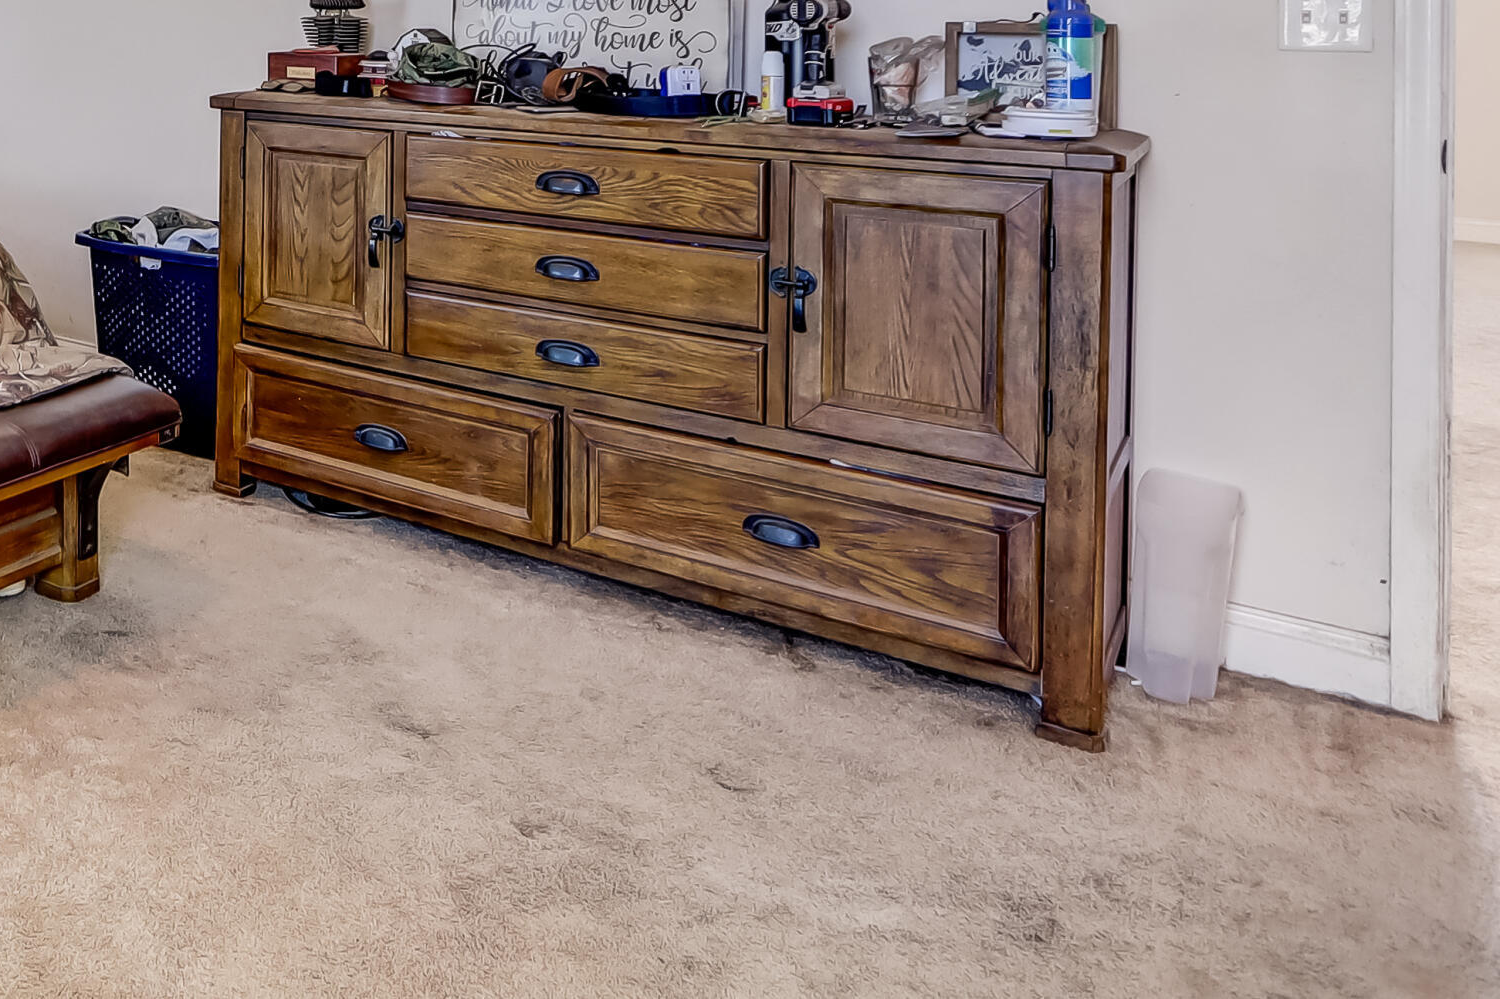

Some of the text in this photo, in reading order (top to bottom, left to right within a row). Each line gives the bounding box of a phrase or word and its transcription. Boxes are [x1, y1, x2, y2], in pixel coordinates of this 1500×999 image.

[466, 12, 717, 60] about my home is
